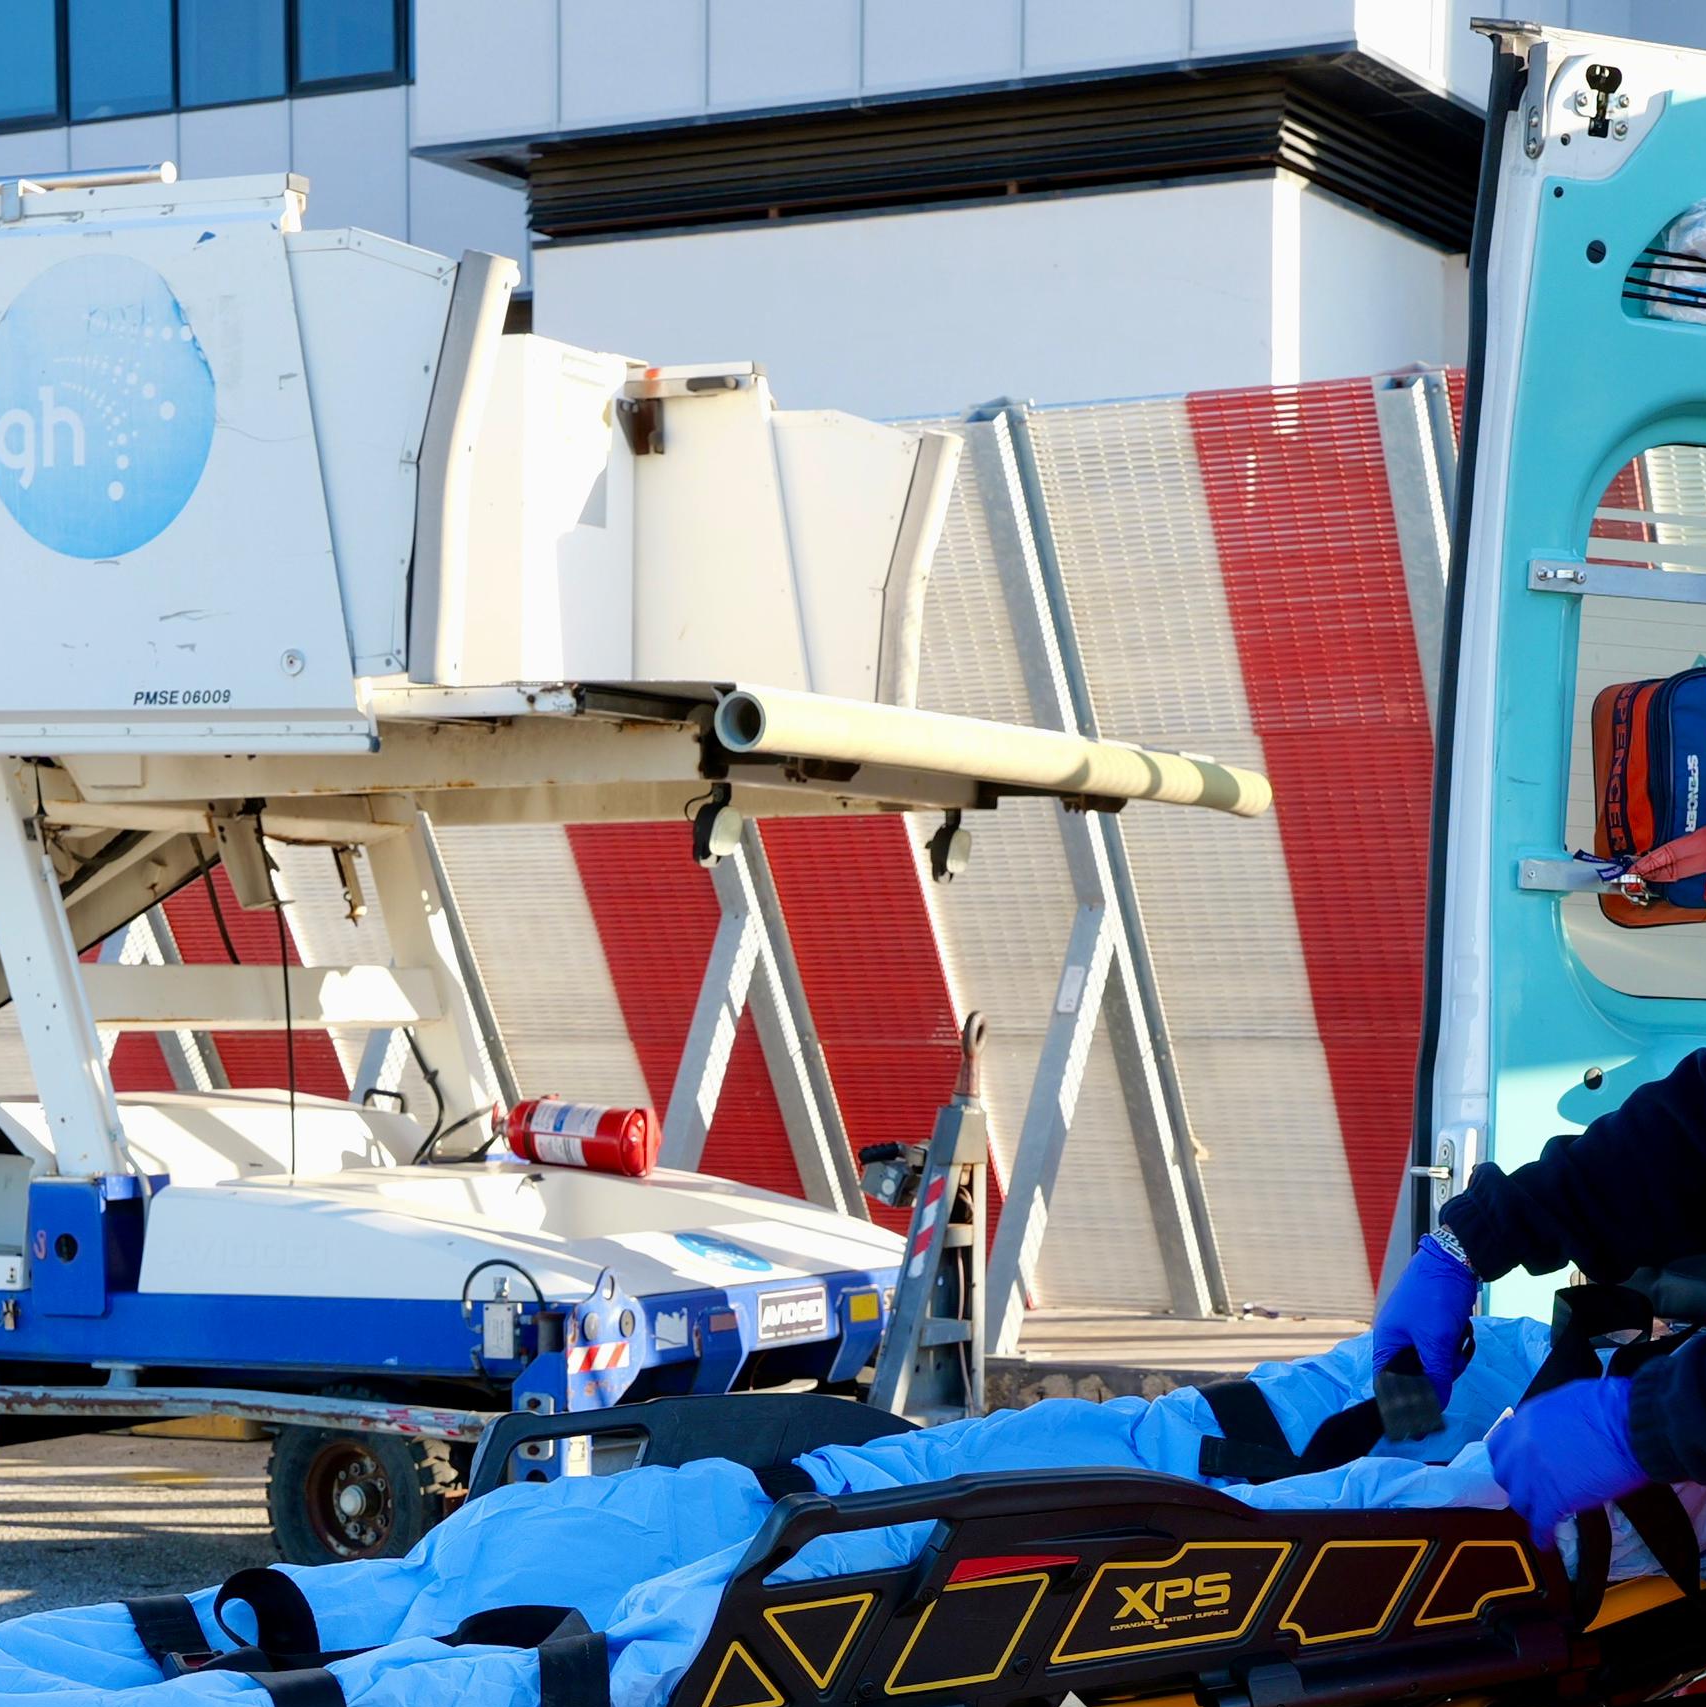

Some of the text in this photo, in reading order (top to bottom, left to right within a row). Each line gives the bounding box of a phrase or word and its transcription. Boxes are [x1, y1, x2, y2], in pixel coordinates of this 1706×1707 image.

[133, 689, 231, 705] PMSE 06009
[1608, 684, 1634, 850] SPENCER
[1685, 755, 1699, 832] SPENCER
[1114, 1572, 1232, 1620] XPS
[1163, 1613, 1193, 1624] PATENT
[1195, 1608, 1230, 1620] SURFACE
